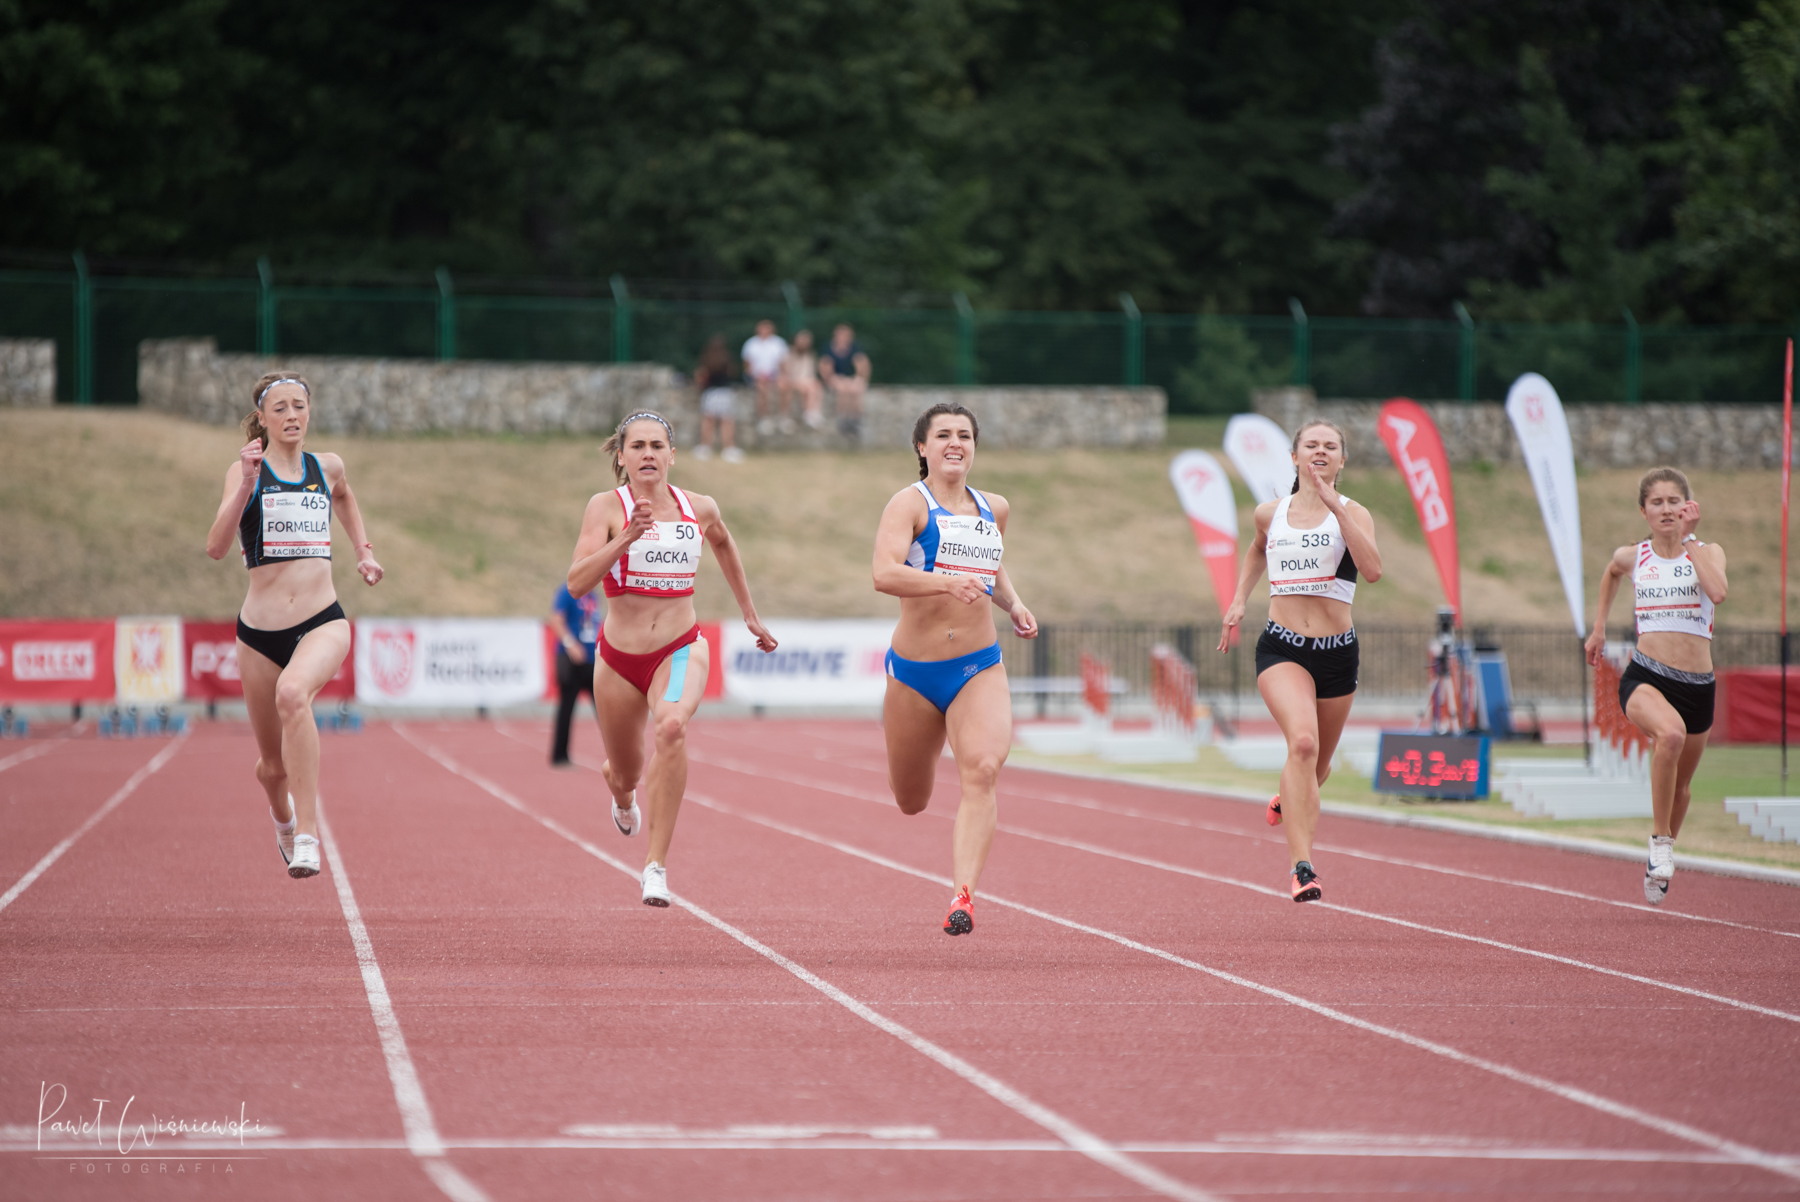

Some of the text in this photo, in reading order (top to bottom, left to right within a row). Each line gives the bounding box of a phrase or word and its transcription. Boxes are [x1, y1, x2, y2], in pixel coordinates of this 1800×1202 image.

[300, 495, 327, 510] 465
[267, 520, 328, 532] FORMELLA
[675, 525, 695, 540] 50
[1301, 533, 1330, 548] 538
[271, 547, 325, 556] RACIBÓRZ 2019
[645, 550, 689, 564] GACKA
[940, 541, 1002, 561] STEFANOWICZ
[1281, 557, 1319, 571] POLAK
[1673, 564, 1692, 578] 83
[635, 578, 690, 588] RACIBÓRZ 2019
[1278, 583, 1328, 593] ACIBÓRZ 2019
[1637, 585, 1699, 600] SKRZYPNIK
[1641, 610, 1675, 619] RACIBÓRZ
[1676, 610, 1693, 618] 2019
[1269, 623, 1306, 647] PRO
[1312, 630, 1353, 650] NIKE
